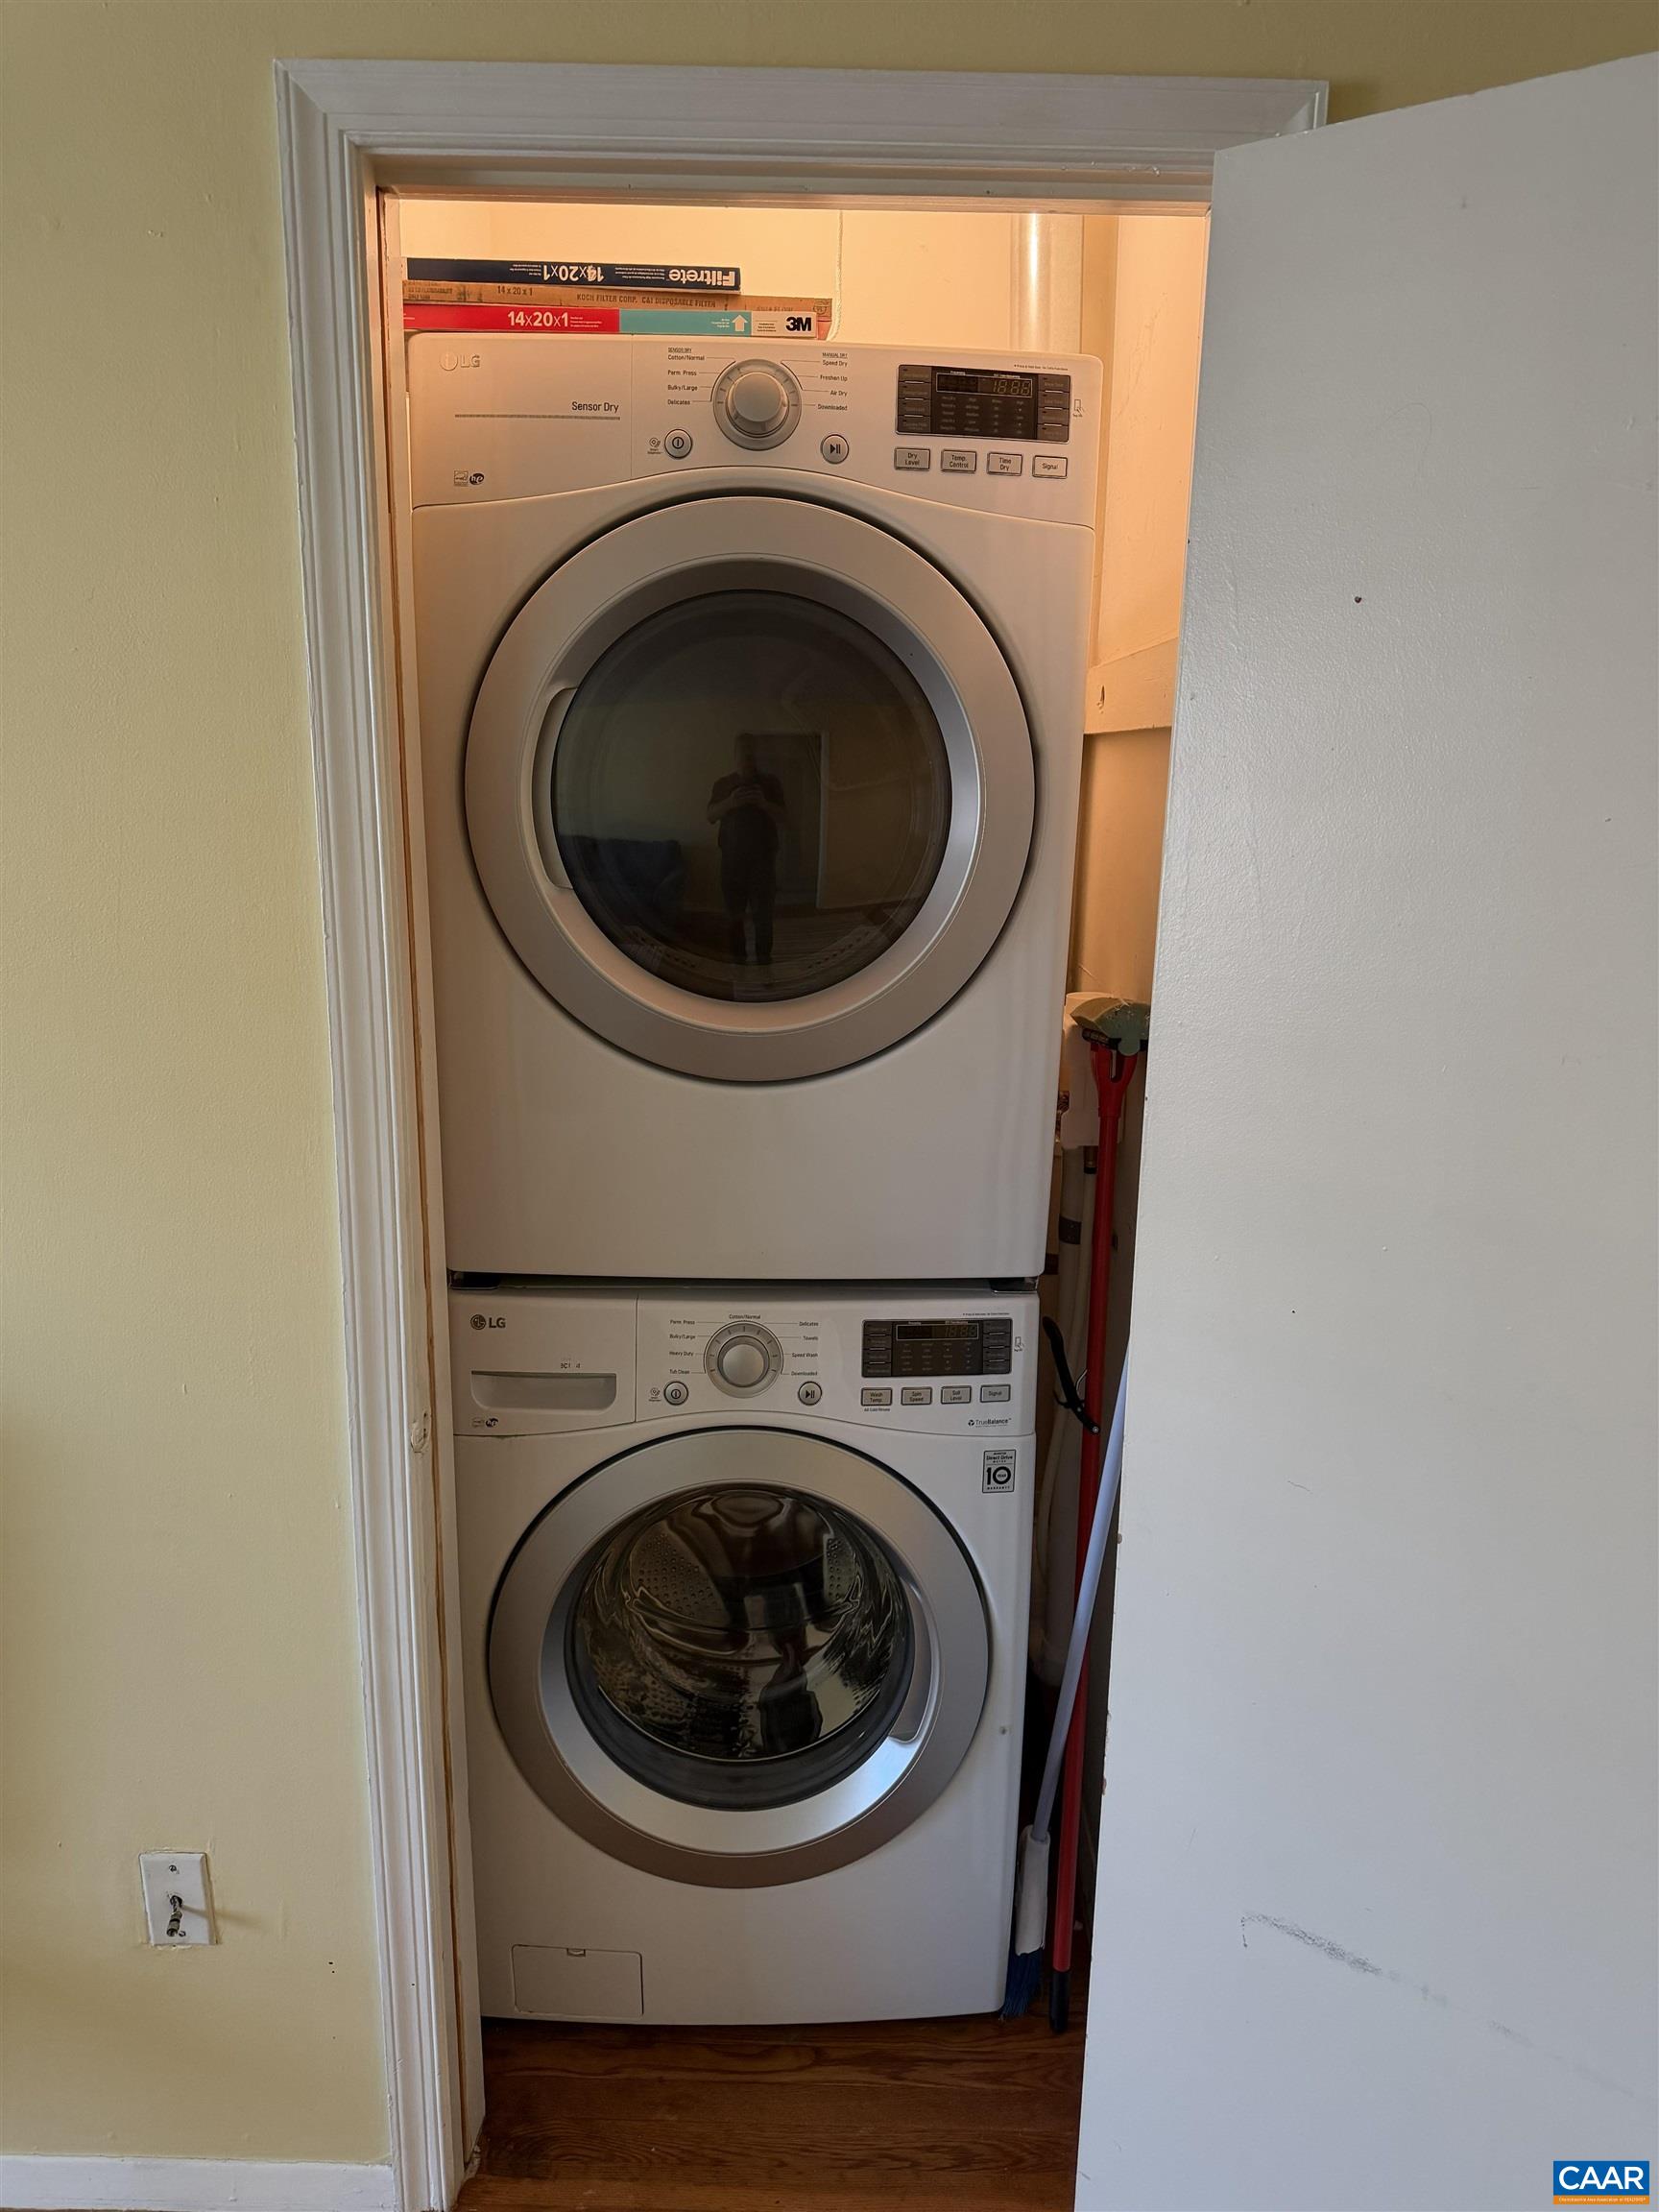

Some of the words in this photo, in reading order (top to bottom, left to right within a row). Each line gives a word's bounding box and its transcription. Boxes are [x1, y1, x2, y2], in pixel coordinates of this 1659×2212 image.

[668, 268, 735, 287] Filtrete
[497, 285, 506, 294] 14
[513, 287, 521, 296] 20
[576, 293, 595, 301] KOCH
[596, 294, 617, 302] FILTER
[618, 295, 638, 303] CORP.
[655, 297, 693, 307] DISPOSABLE
[694, 300, 716, 308] FILTER
[508, 310, 569, 327] 14x20x1
[785, 316, 812, 332] 3M
[460, 354, 481, 369] LG
[571, 400, 602, 412] Sensor
[604, 401, 619, 414] Dry
[1042, 462, 1059, 470] Signal
[488, 1317, 506, 1329] LG
[986, 1466, 1012, 1485] 10
